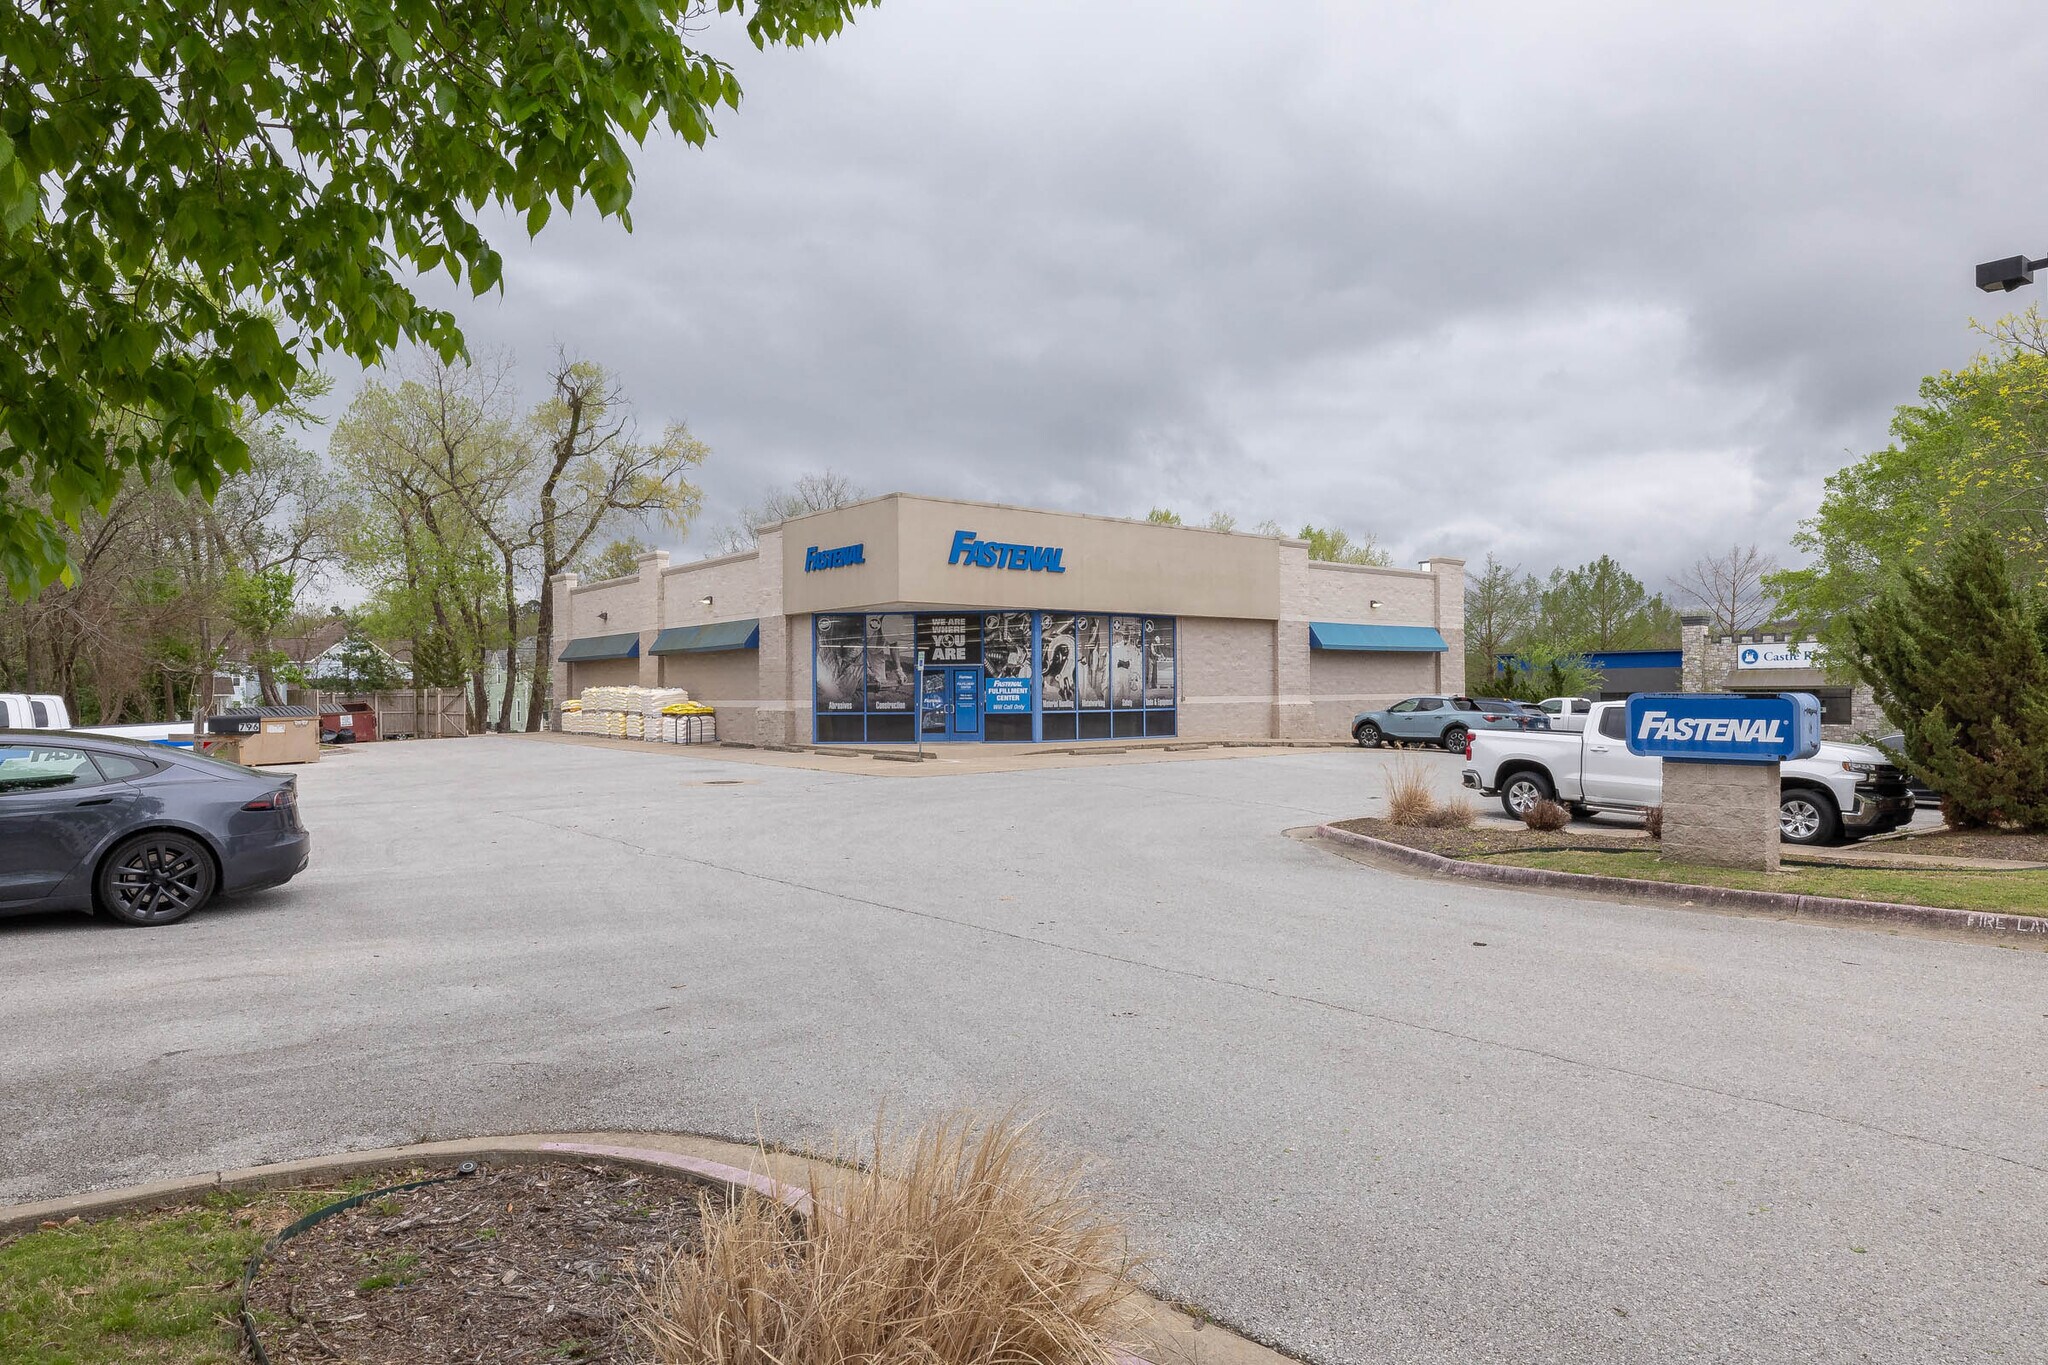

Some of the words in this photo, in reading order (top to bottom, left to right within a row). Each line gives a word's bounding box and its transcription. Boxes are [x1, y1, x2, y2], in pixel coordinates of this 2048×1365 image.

[804, 543, 866, 572] FASTENAL
[948, 530, 1066, 573] FASTENAL
[932, 648, 966, 660] ARE
[1763, 651, 1800, 662] Castle
[239, 723, 259, 731] 796
[1637, 711, 1785, 743] FASTENAL
[1967, 914, 2006, 930] FIRE
